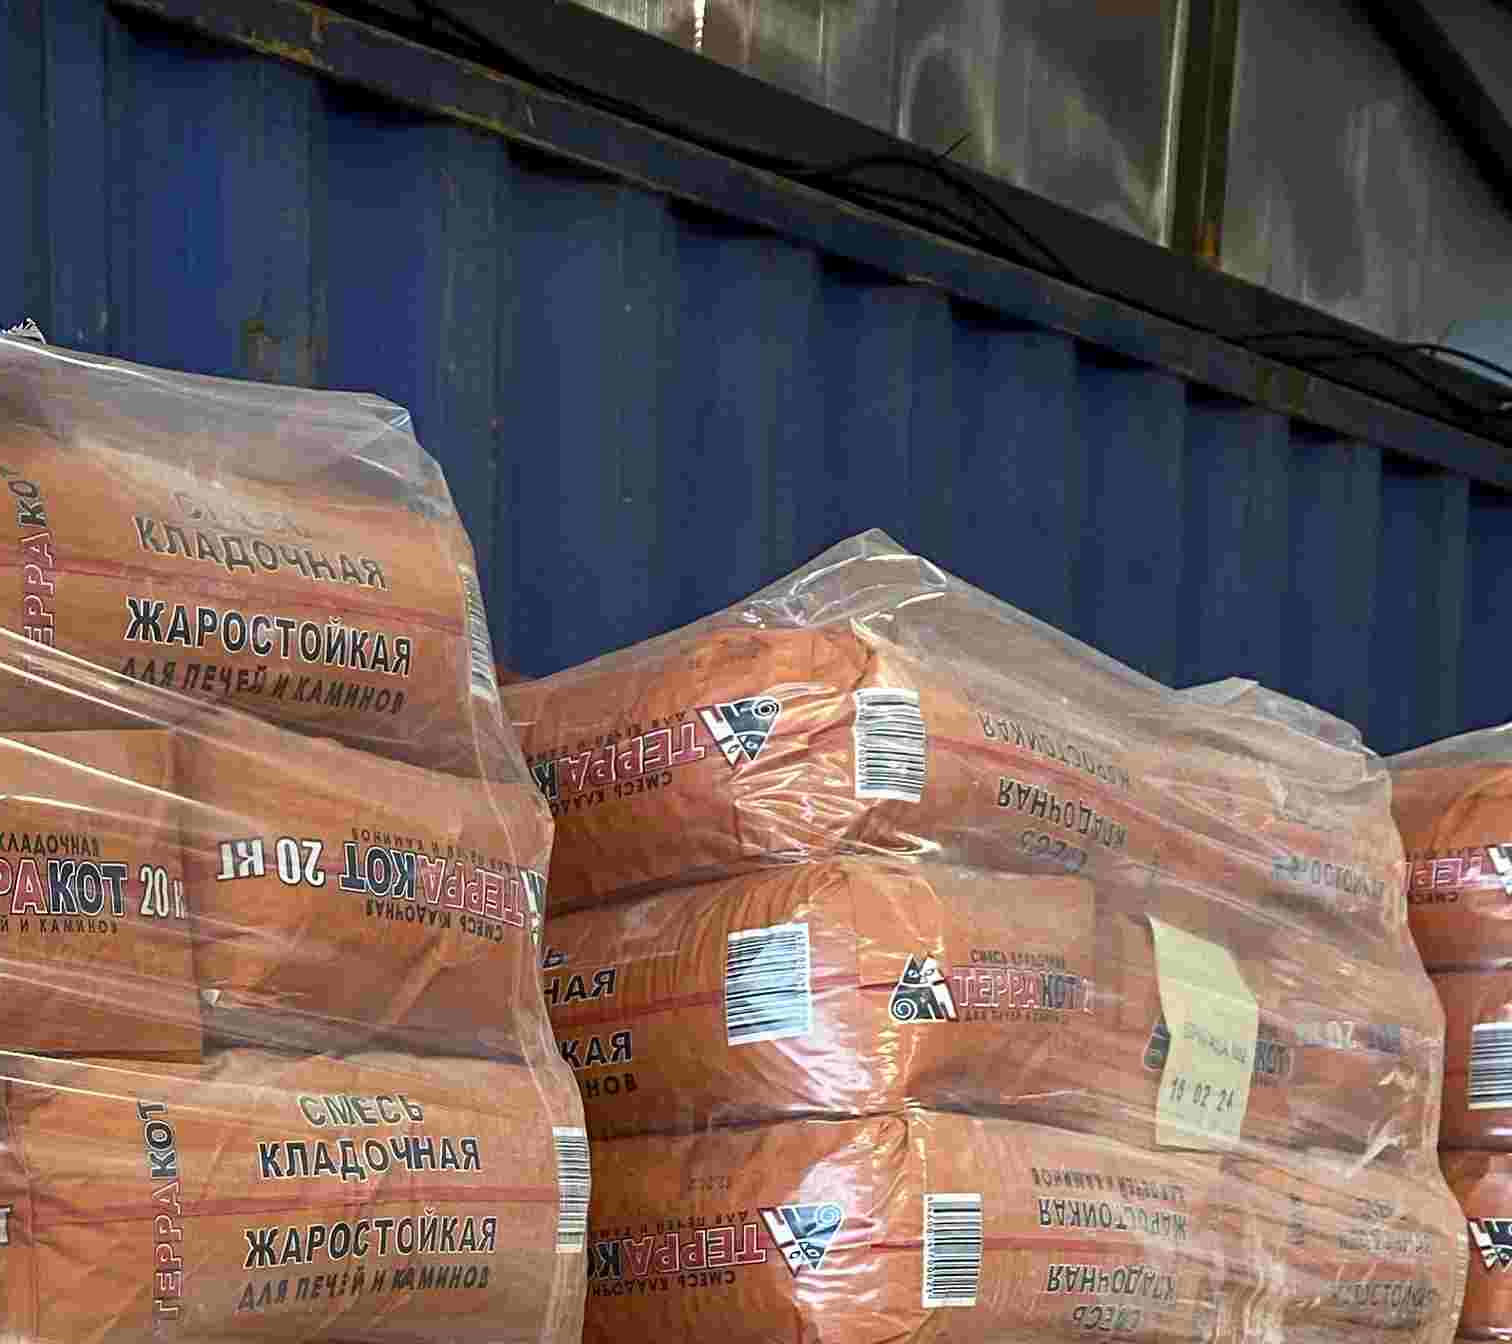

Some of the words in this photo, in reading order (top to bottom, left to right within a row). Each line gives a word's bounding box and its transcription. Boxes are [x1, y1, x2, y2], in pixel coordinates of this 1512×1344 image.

[133, 514, 388, 591] КЛАДОЧНАЯ
[126, 597, 412, 678] ЖАРОСТОЙКАЯ
[183, 659, 269, 699] ПЕЧЕЙ
[293, 675, 408, 716] КАМИНОВ
[277, 838, 326, 886] 20
[338, 841, 527, 926] ТЕРРАКОТ
[139, 865, 169, 918] 20
[20, 918, 32, 933] И
[39, 917, 118, 935] КАМИНОВ
[298, 1094, 425, 1127] СМЕСЬ
[257, 1136, 482, 1182] КЛАДОЧНАЯ
[243, 1208, 497, 1271] ЖАРОСТОЙКАЯ
[235, 1279, 289, 1313] ДЛЯ
[295, 1272, 365, 1300] ПЕЧЕЙ
[391, 1264, 489, 1291] КАМИНОВ
[1046, 1263, 1177, 1304] КЛАДОЧНАЯ
